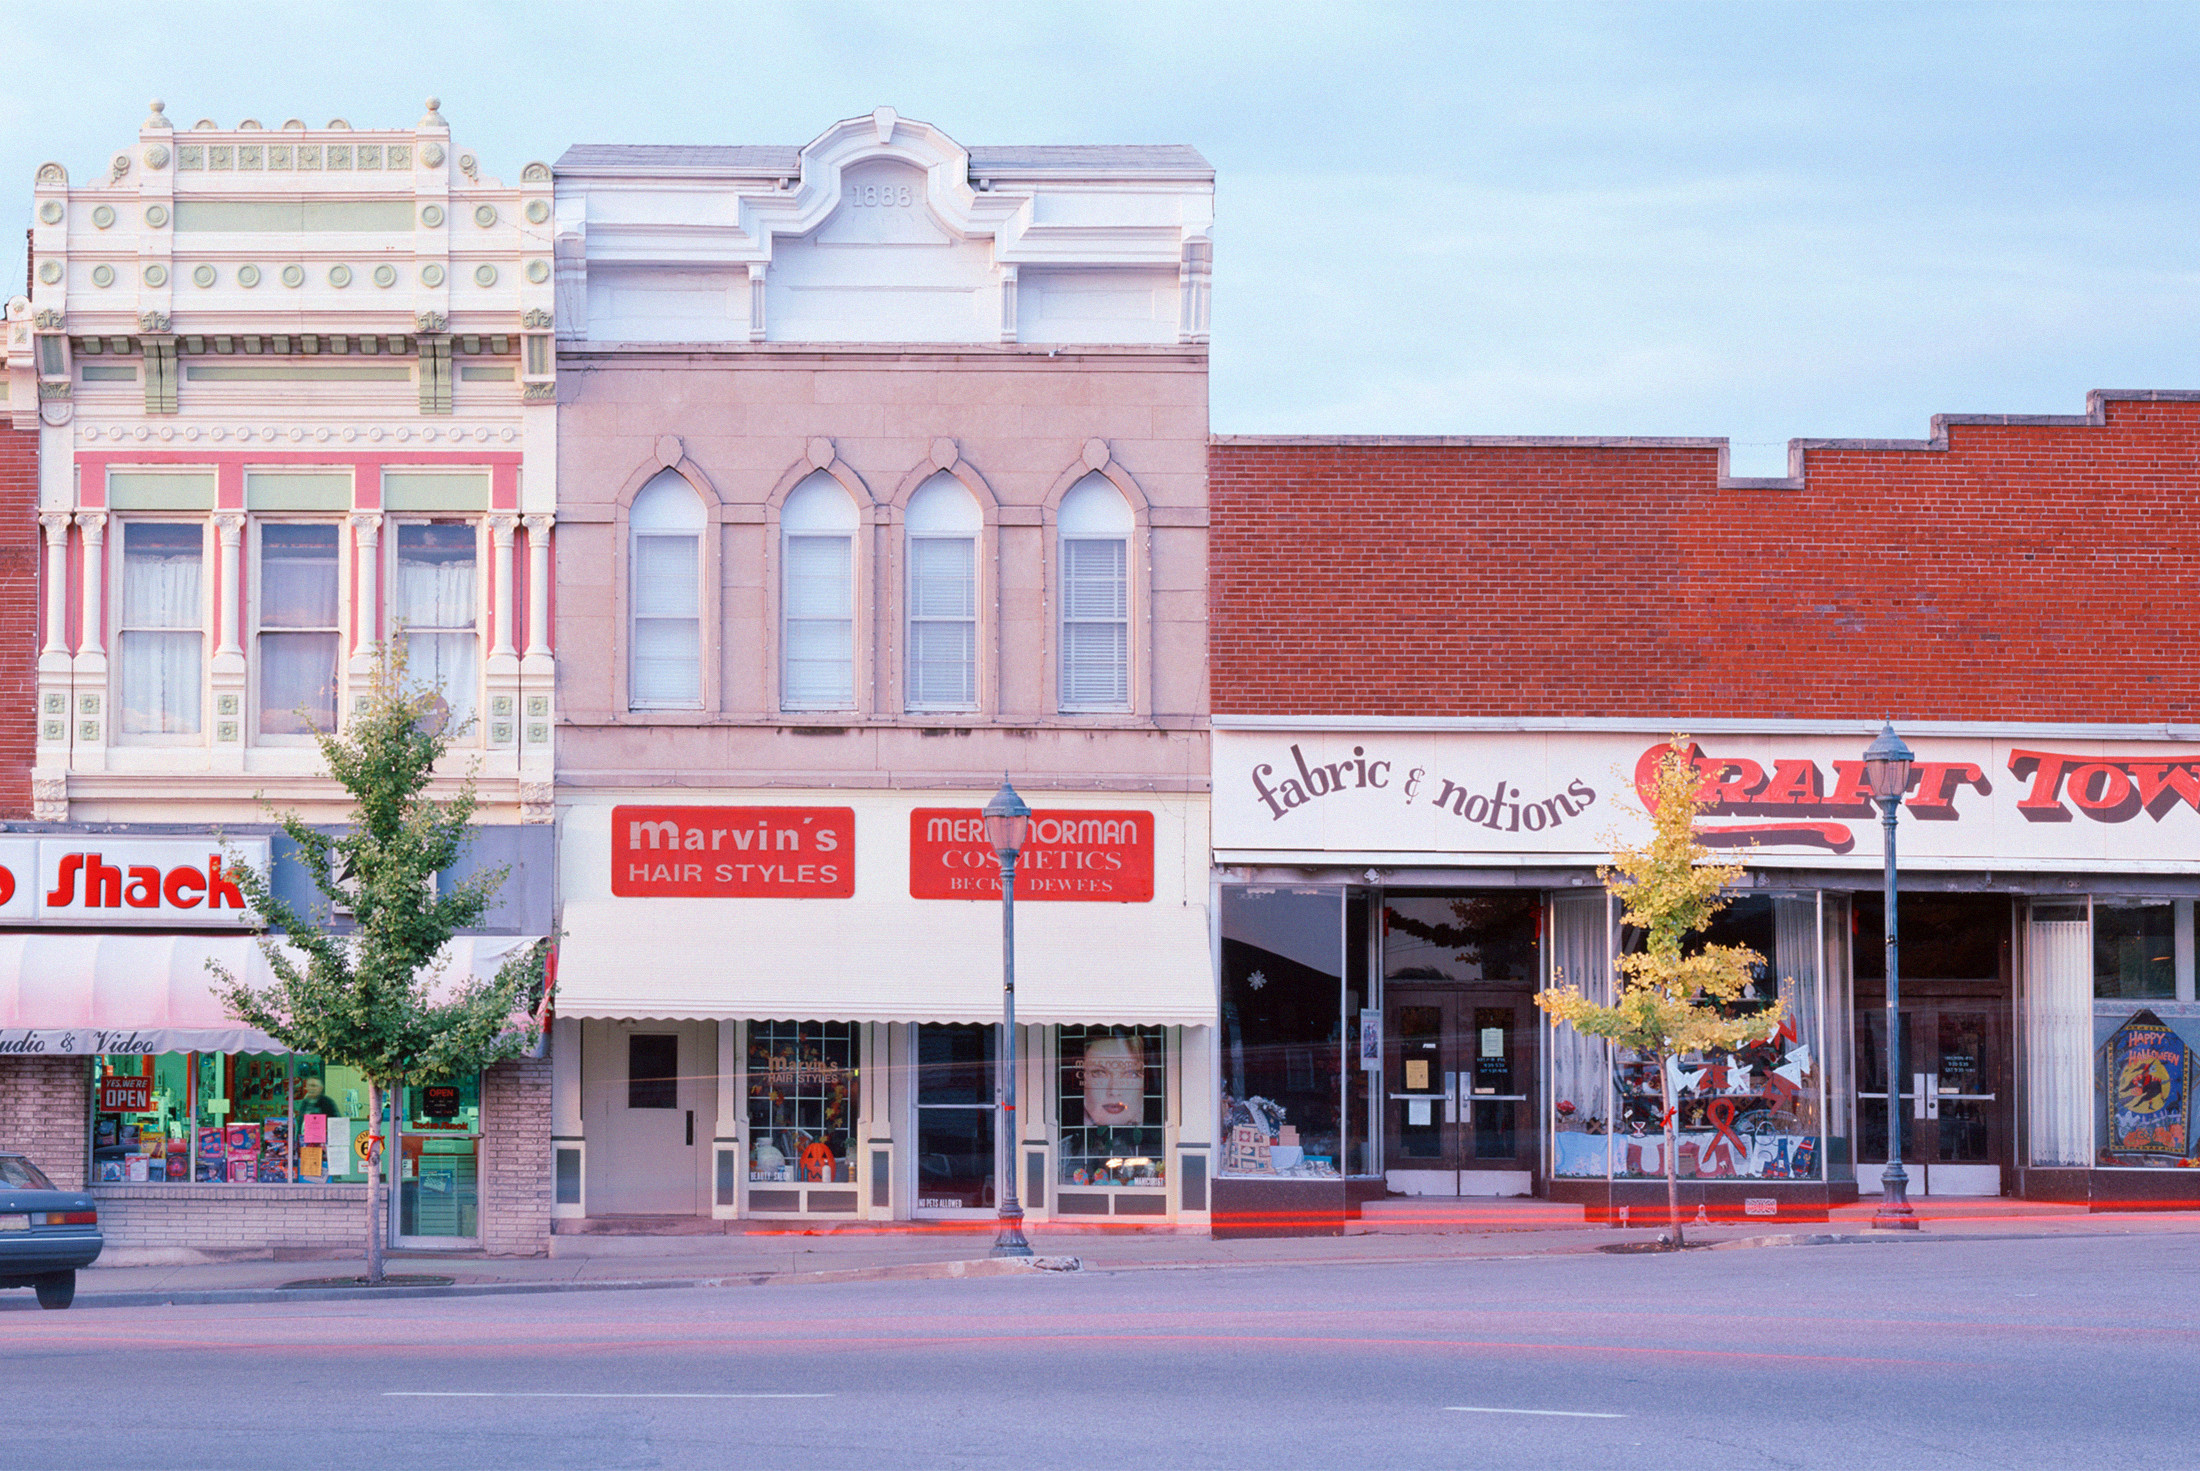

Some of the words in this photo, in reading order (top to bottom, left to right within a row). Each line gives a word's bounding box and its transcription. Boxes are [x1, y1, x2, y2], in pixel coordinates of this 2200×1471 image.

[853, 184, 911, 208] 1886
[1252, 744, 1391, 821] fabric
[1404, 765, 1426, 805] &
[1432, 777, 1597, 833] notions
[629, 817, 839, 852] marvin's
[927, 818, 992, 842] MER
[942, 850, 1122, 870] COSMETICS
[47, 852, 247, 909] Shack
[629, 864, 702, 882] HAIR
[715, 864, 838, 884] STYLES
[951, 877, 1005, 890] BECK
[1031, 879, 1113, 892] DEWEES
[60, 1032, 76, 1053] &
[93, 1030, 154, 1053] Video
[2128, 1031, 2166, 1048] HAPPY
[2128, 1048, 2180, 1067] HALLOWEEN
[768, 1074, 798, 1083] HAIR
[798, 1074, 839, 1083] STYLES
[105, 1090, 147, 1108] OPEN
[429, 1088, 454, 1097] OPEN
[926, 1199, 939, 1208] PETS
[939, 1199, 963, 1208] ALLOWED
